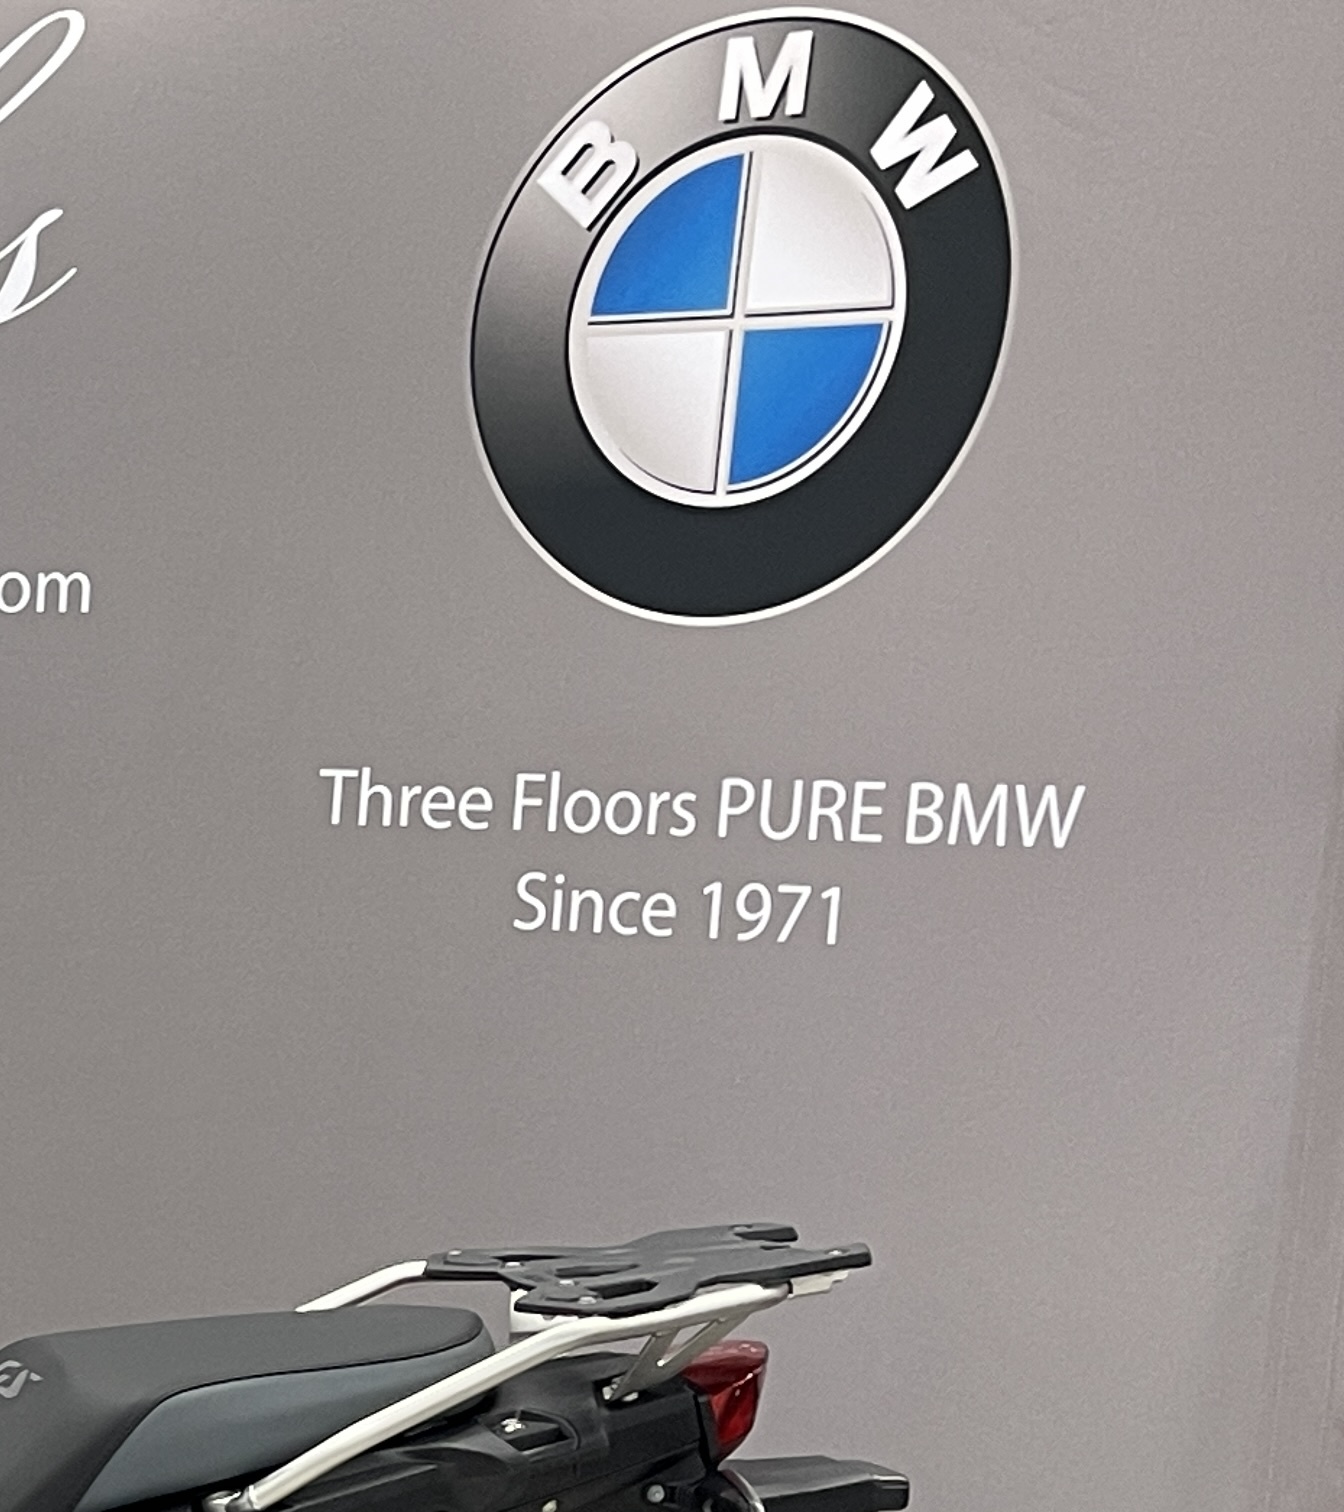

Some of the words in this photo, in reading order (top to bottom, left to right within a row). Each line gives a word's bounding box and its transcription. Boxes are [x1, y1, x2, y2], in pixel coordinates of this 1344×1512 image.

[536, 30, 980, 228] BMW
[319, 766, 493, 830] Three
[512, 770, 698, 837] Floors
[717, 777, 887, 843] PURE
[905, 781, 1087, 849] BMW
[513, 871, 677, 937] Since
[702, 881, 842, 945] 1971
